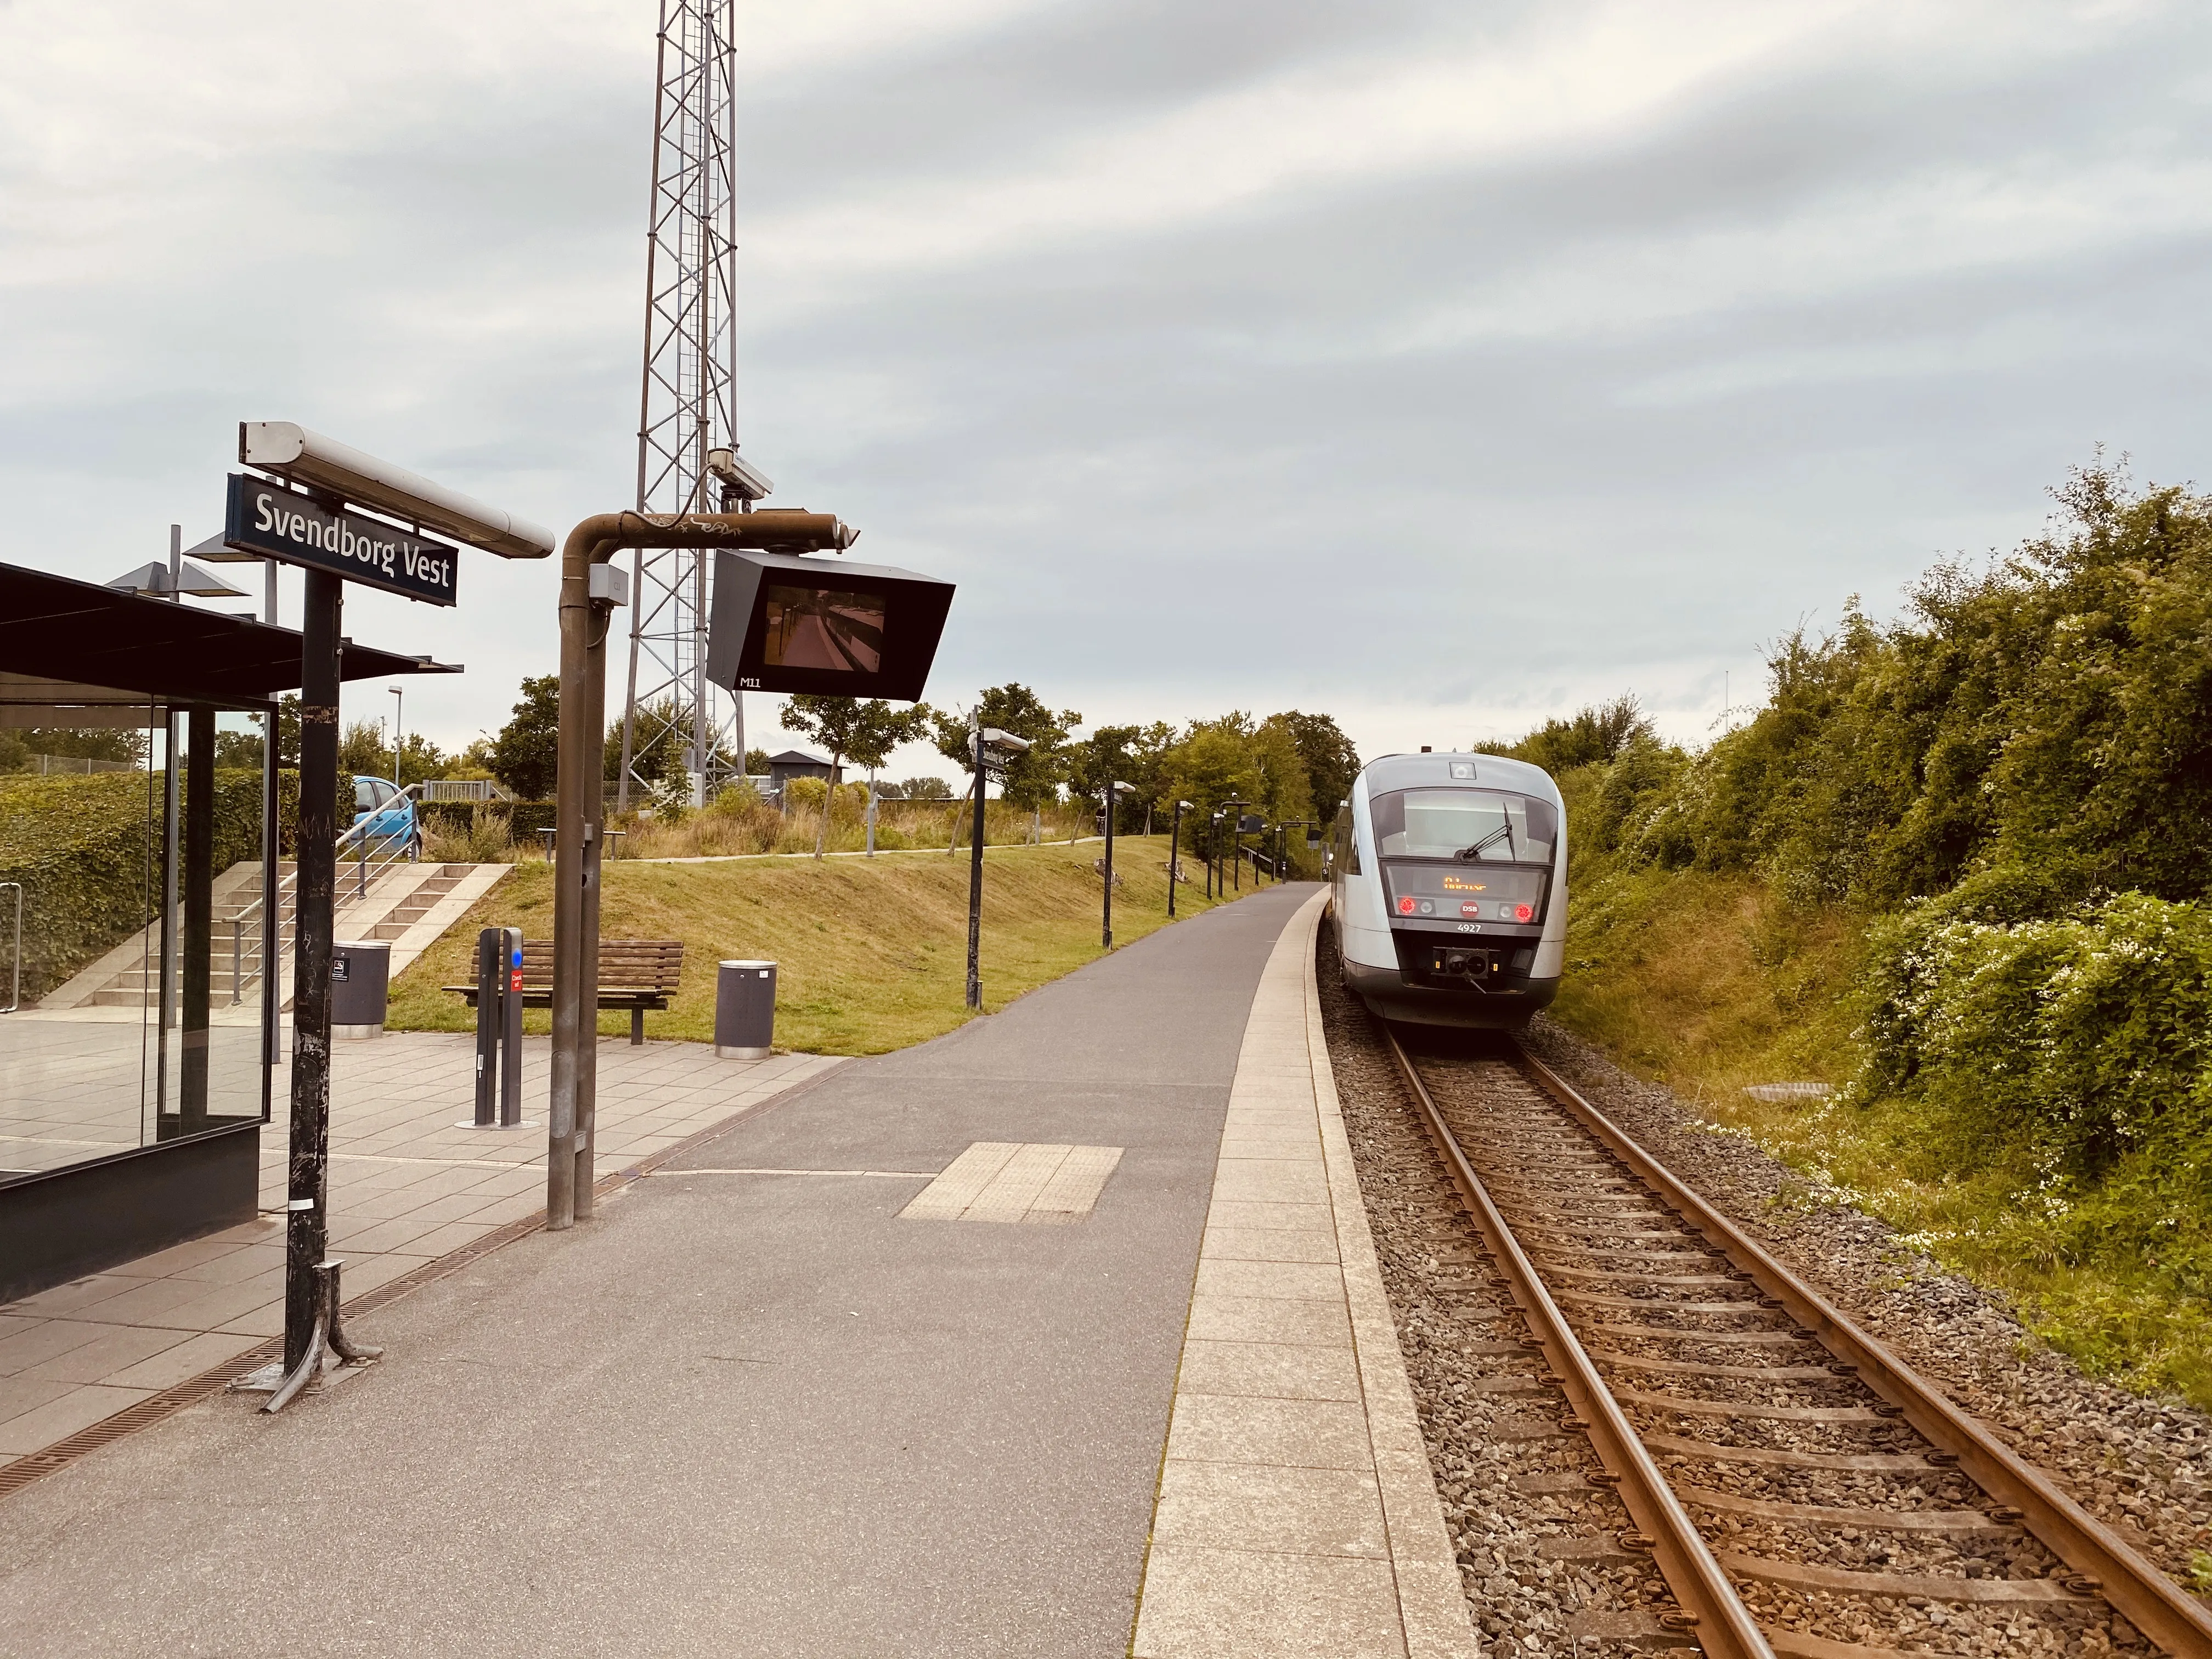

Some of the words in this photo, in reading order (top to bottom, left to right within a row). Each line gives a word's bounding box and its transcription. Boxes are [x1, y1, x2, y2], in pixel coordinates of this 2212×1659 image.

[255, 493, 395, 578] Svendborg
[403, 541, 449, 588] Vest
[740, 677, 761, 688] M11
[1457, 924, 1481, 933] 4927
